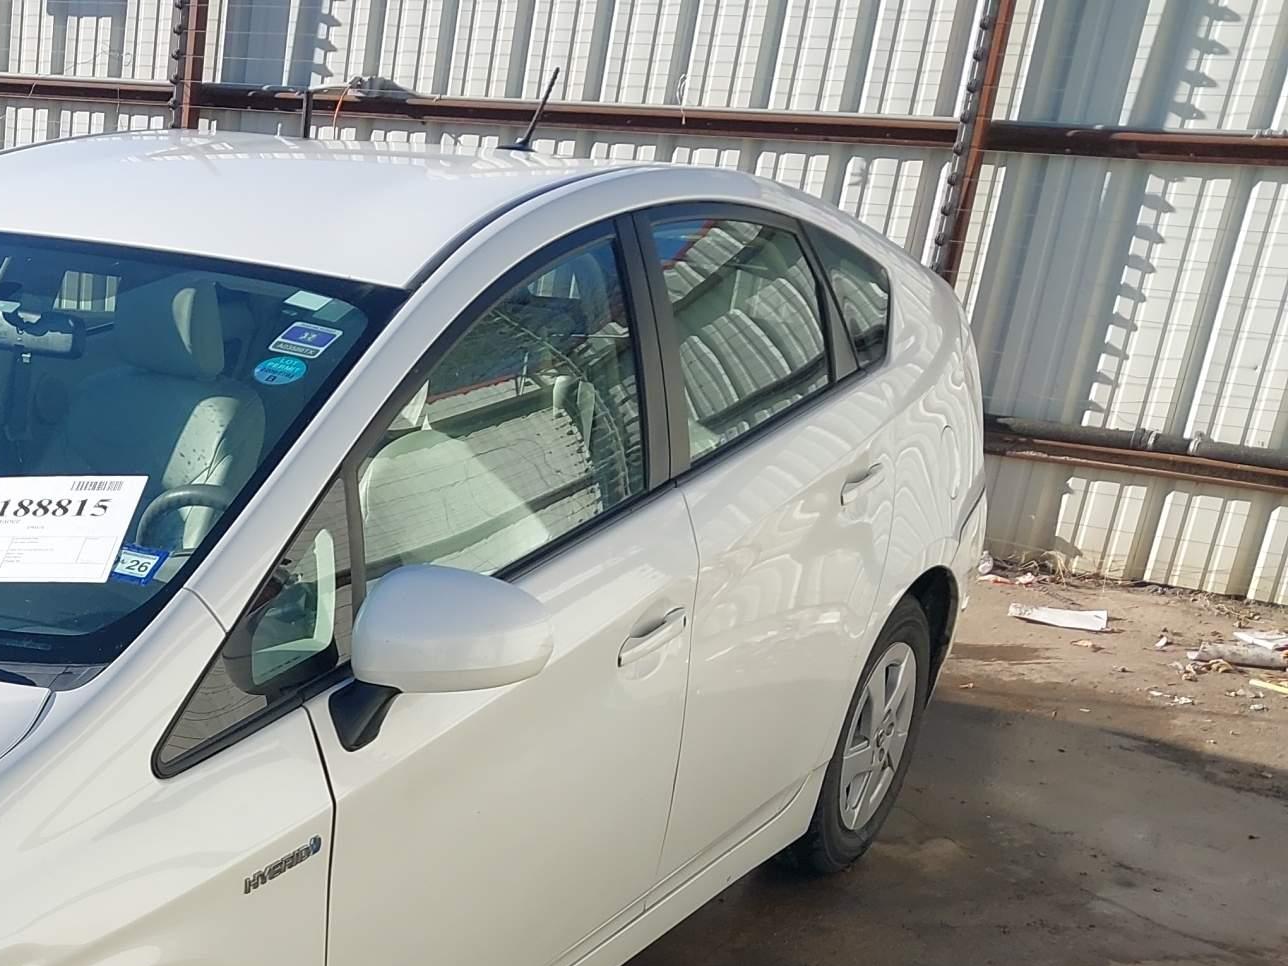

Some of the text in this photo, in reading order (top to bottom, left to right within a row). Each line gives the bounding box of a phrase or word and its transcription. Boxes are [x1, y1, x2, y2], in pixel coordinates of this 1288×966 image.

[266, 362, 300, 373] PERMIT
[125, 559, 151, 573] 26
[243, 844, 312, 894] HYBRID
